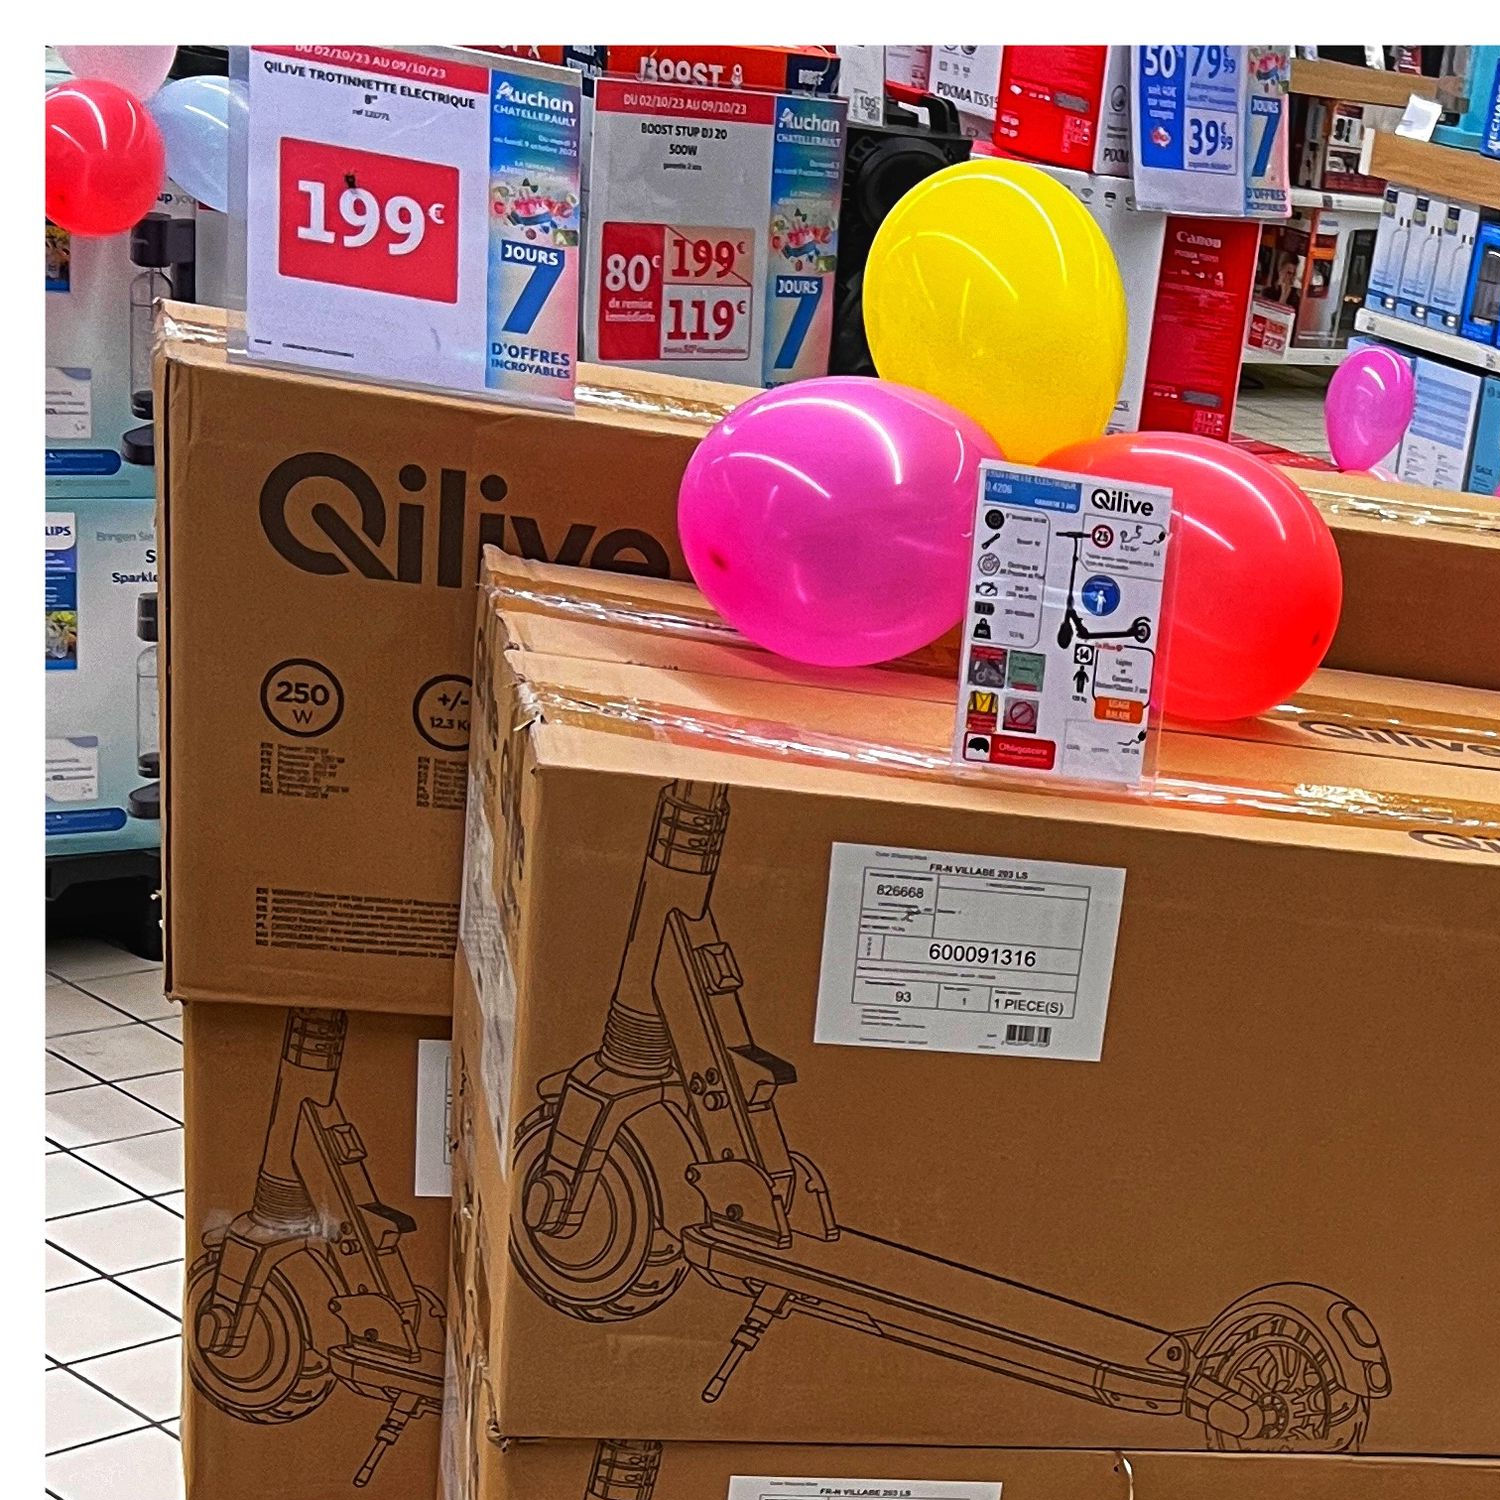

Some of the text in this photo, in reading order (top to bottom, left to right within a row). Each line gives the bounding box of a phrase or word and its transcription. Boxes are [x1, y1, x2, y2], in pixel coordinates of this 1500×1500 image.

[372, 56, 390, 69] AU
[391, 58, 446, 79] 09/10/23
[639, 55, 724, 87] BOOST
[263, 60, 475, 109] QILIVE TROTINNETTE ELECTRIQUE
[936, 81, 972, 102] PIXMA
[495, 80, 574, 114] Auchan
[623, 93, 747, 115] DU 02/10/23 AU 09/10/23
[493, 103, 577, 127] CHATELLERAULT
[779, 107, 840, 133] Auchan
[641, 122, 675, 137] BOOST
[715, 128, 728, 140] 20
[1251, 95, 1282, 177] 7
[669, 143, 698, 156] 500W
[297, 179, 446, 256] 199€
[1176, 230, 1222, 249] Canon
[504, 243, 559, 267] JOURS
[604, 253, 661, 293] 80€
[501, 239, 565, 334] 7
[777, 280, 819, 295] JOURS
[667, 299, 747, 341] 119€
[773, 274, 824, 370] 7
[491, 341, 571, 367] D'OFFRES
[491, 357, 571, 379] INCROYABLES
[1091, 488, 1154, 517] Qilive
[274, 681, 330, 704] 250
[293, 708, 313, 725] W
[876, 883, 925, 899] 826668
[928, 943, 1037, 968] 600091316
[895, 991, 912, 1003] 93
[1003, 998, 1064, 1016] PIECE(S)
